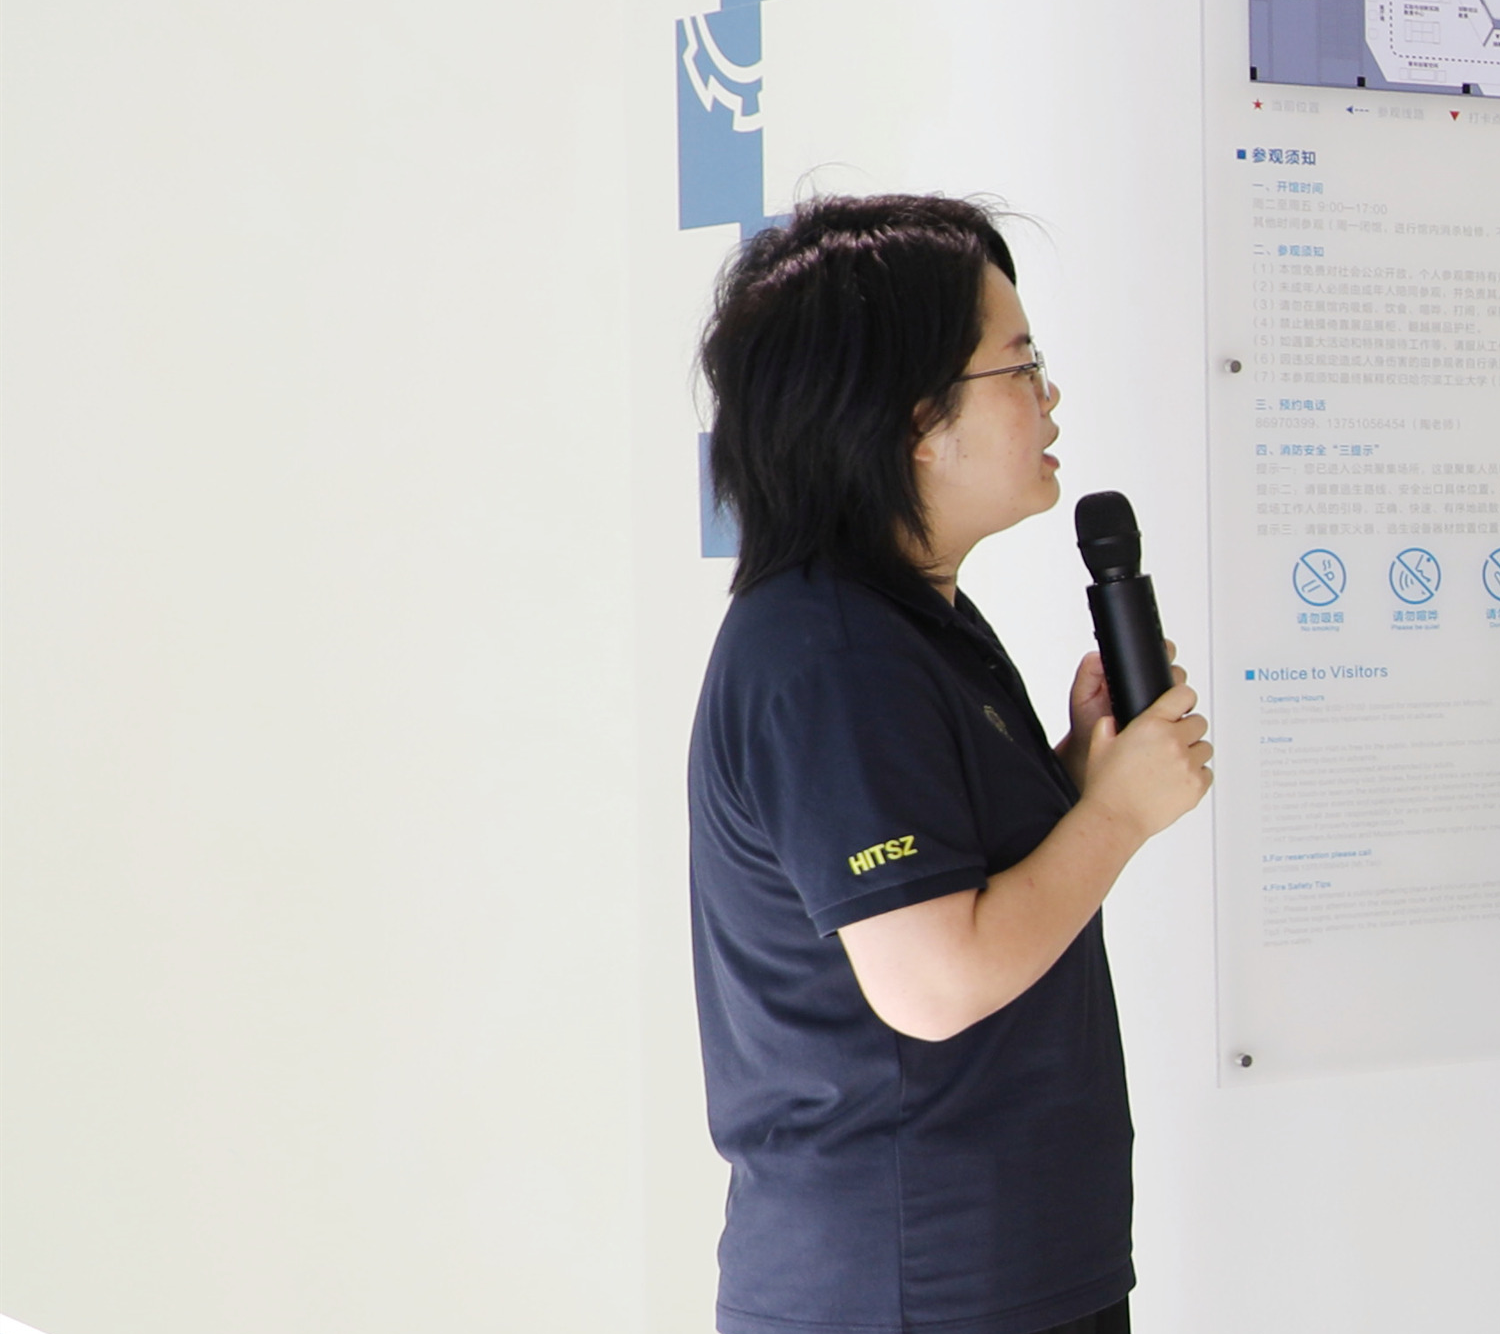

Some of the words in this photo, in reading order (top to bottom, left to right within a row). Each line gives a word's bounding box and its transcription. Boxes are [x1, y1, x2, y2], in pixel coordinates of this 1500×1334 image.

[1252, 146, 1317, 167] 参观须知
[1255, 398, 1326, 412] 三、预约电话
[1258, 667, 1307, 682] Notice
[1311, 666, 1327, 680] to
[1330, 664, 1388, 681] Visitors
[848, 835, 919, 875] HITSZ
